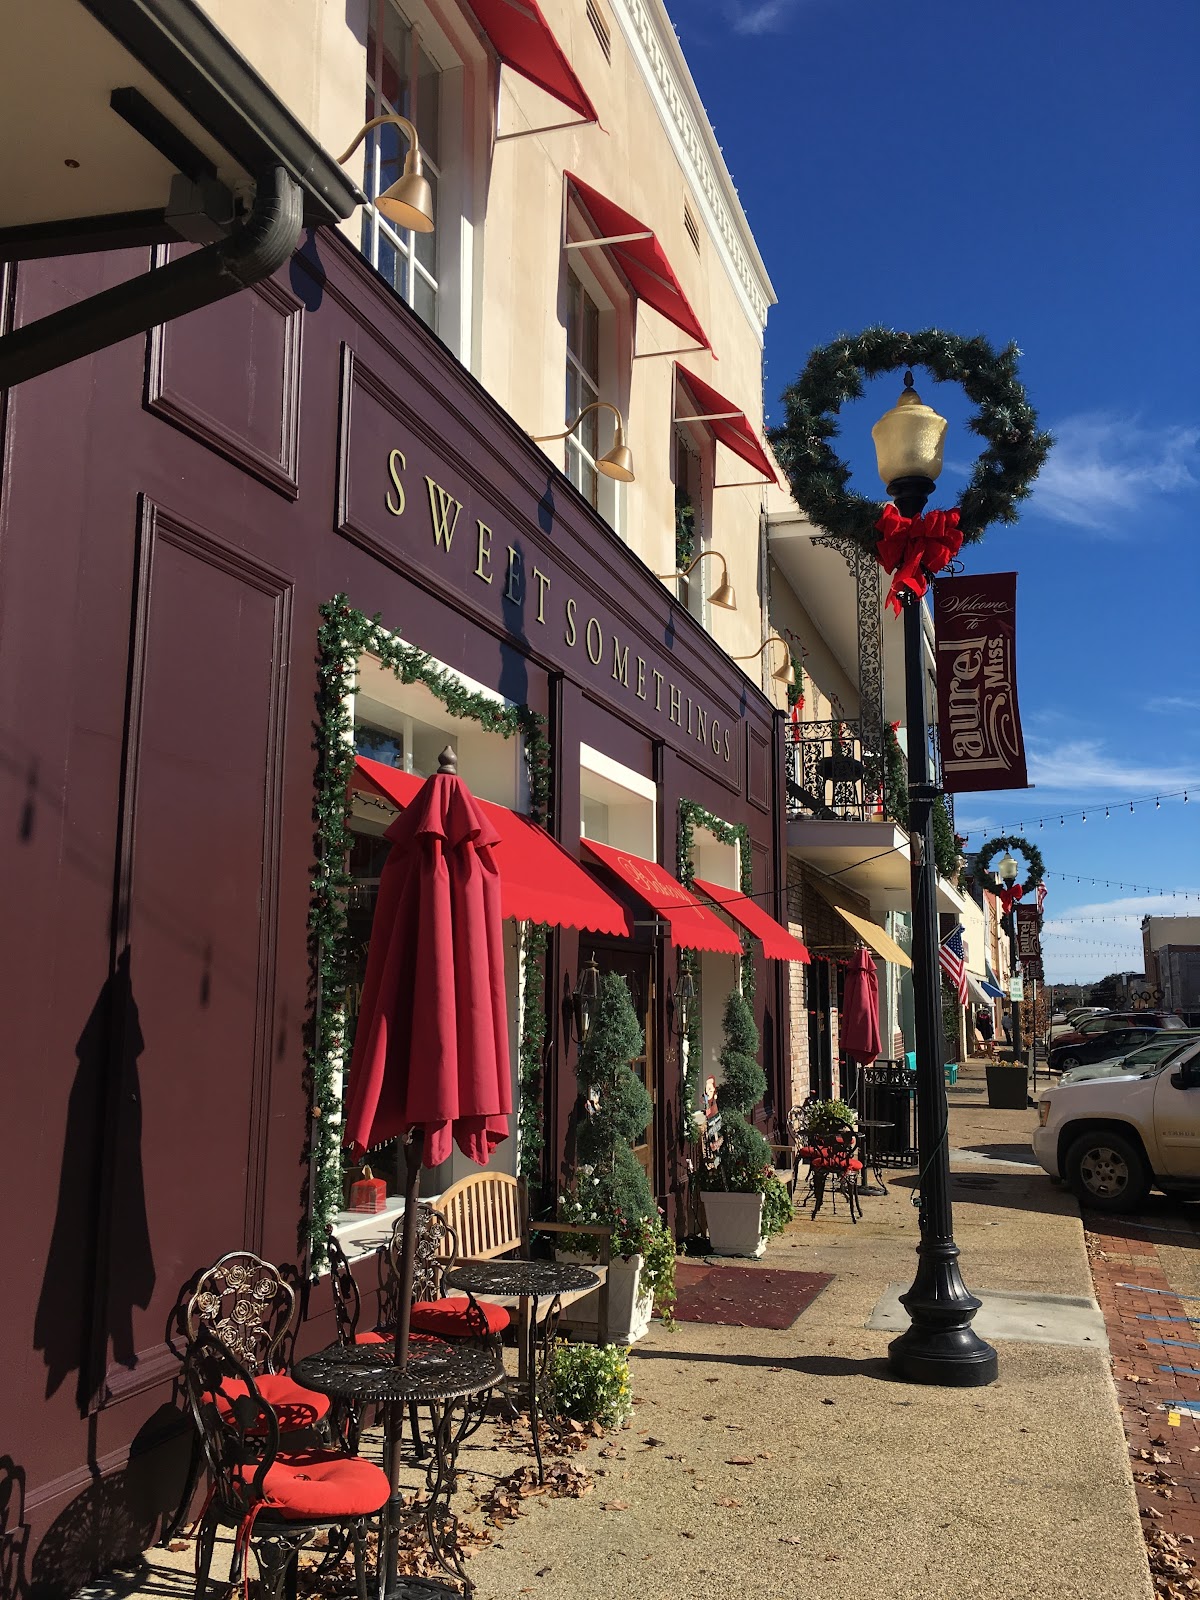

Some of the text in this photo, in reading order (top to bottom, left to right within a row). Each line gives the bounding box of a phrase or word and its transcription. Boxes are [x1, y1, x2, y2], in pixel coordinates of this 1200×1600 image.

[385, 448, 731, 763] SWEET SOMETHINGS
[939, 593, 1014, 613] Welcome
[964, 618, 988, 630] to
[938, 635, 1012, 771] Laurel
[1018, 920, 1036, 956] Laurel
